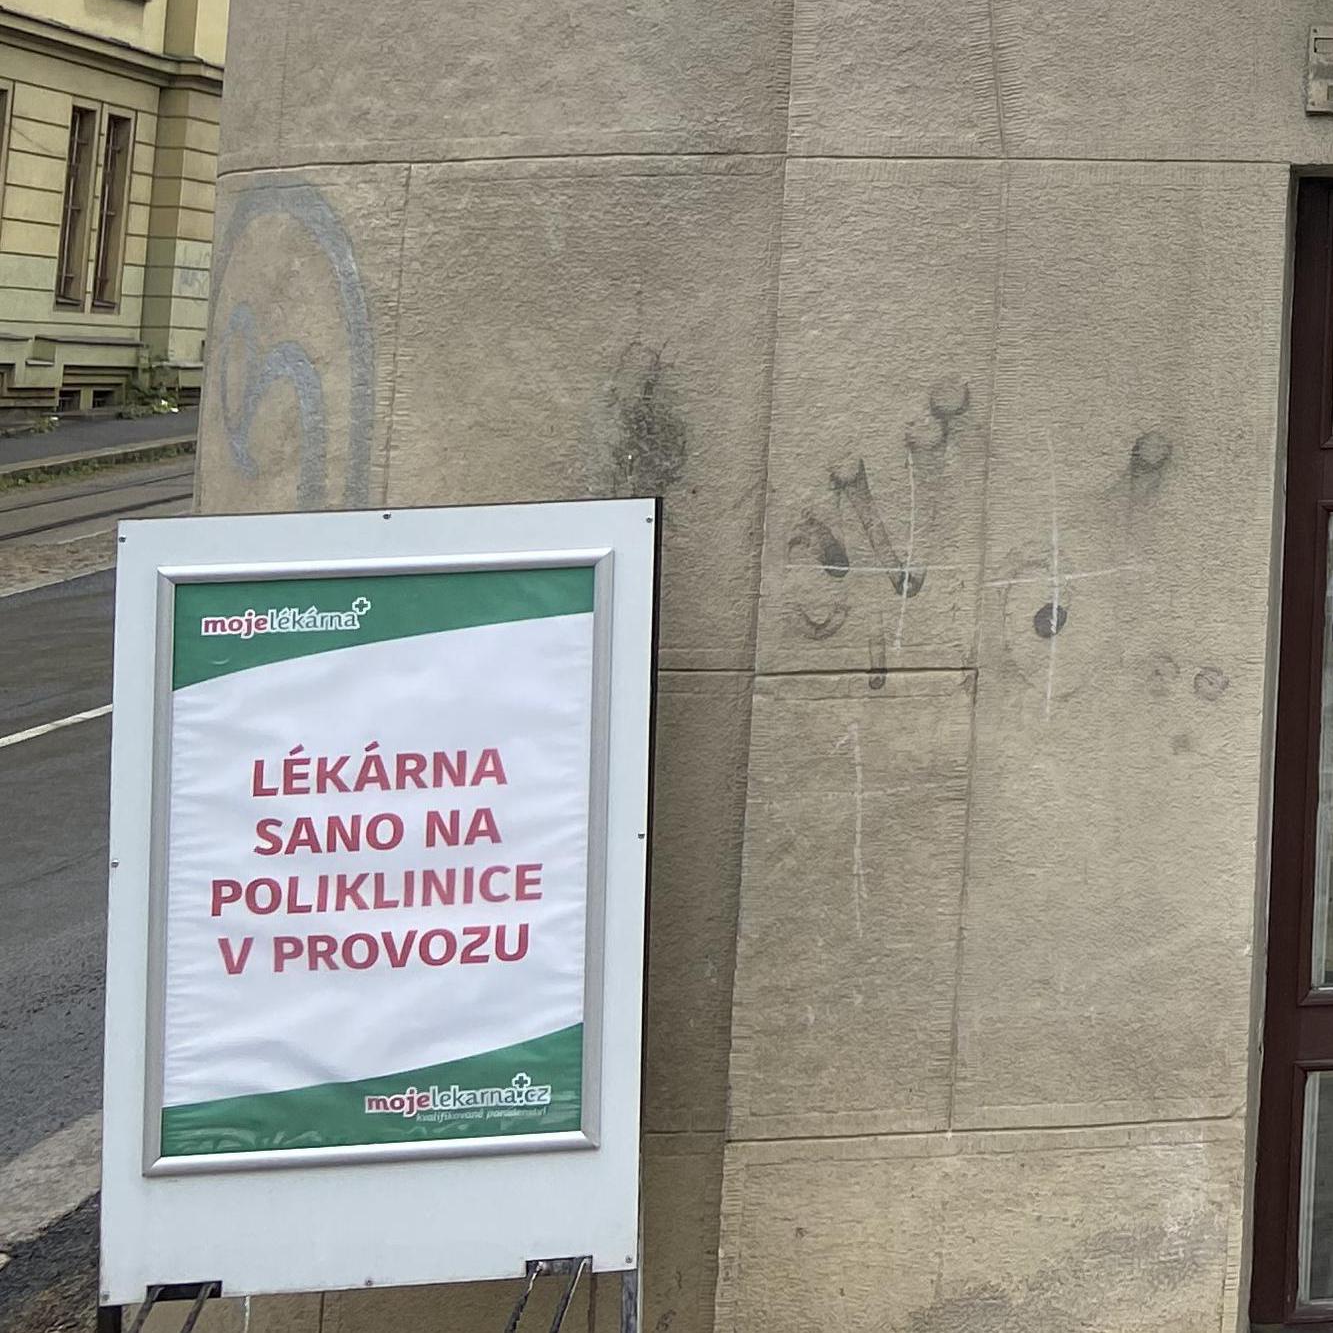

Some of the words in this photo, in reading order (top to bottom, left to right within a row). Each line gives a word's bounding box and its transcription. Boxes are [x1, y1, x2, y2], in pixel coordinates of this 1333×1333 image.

[202, 605, 359, 638] mojelékárna
[251, 740, 509, 798] LÉKÁRNA
[253, 812, 405, 856] SANO
[425, 807, 504, 849] NA
[210, 862, 544, 917] POLIKLINICE
[217, 936, 255, 975] V
[272, 922, 531, 973] PROVOZU
[365, 1085, 551, 1116] mojelekarna.cz
